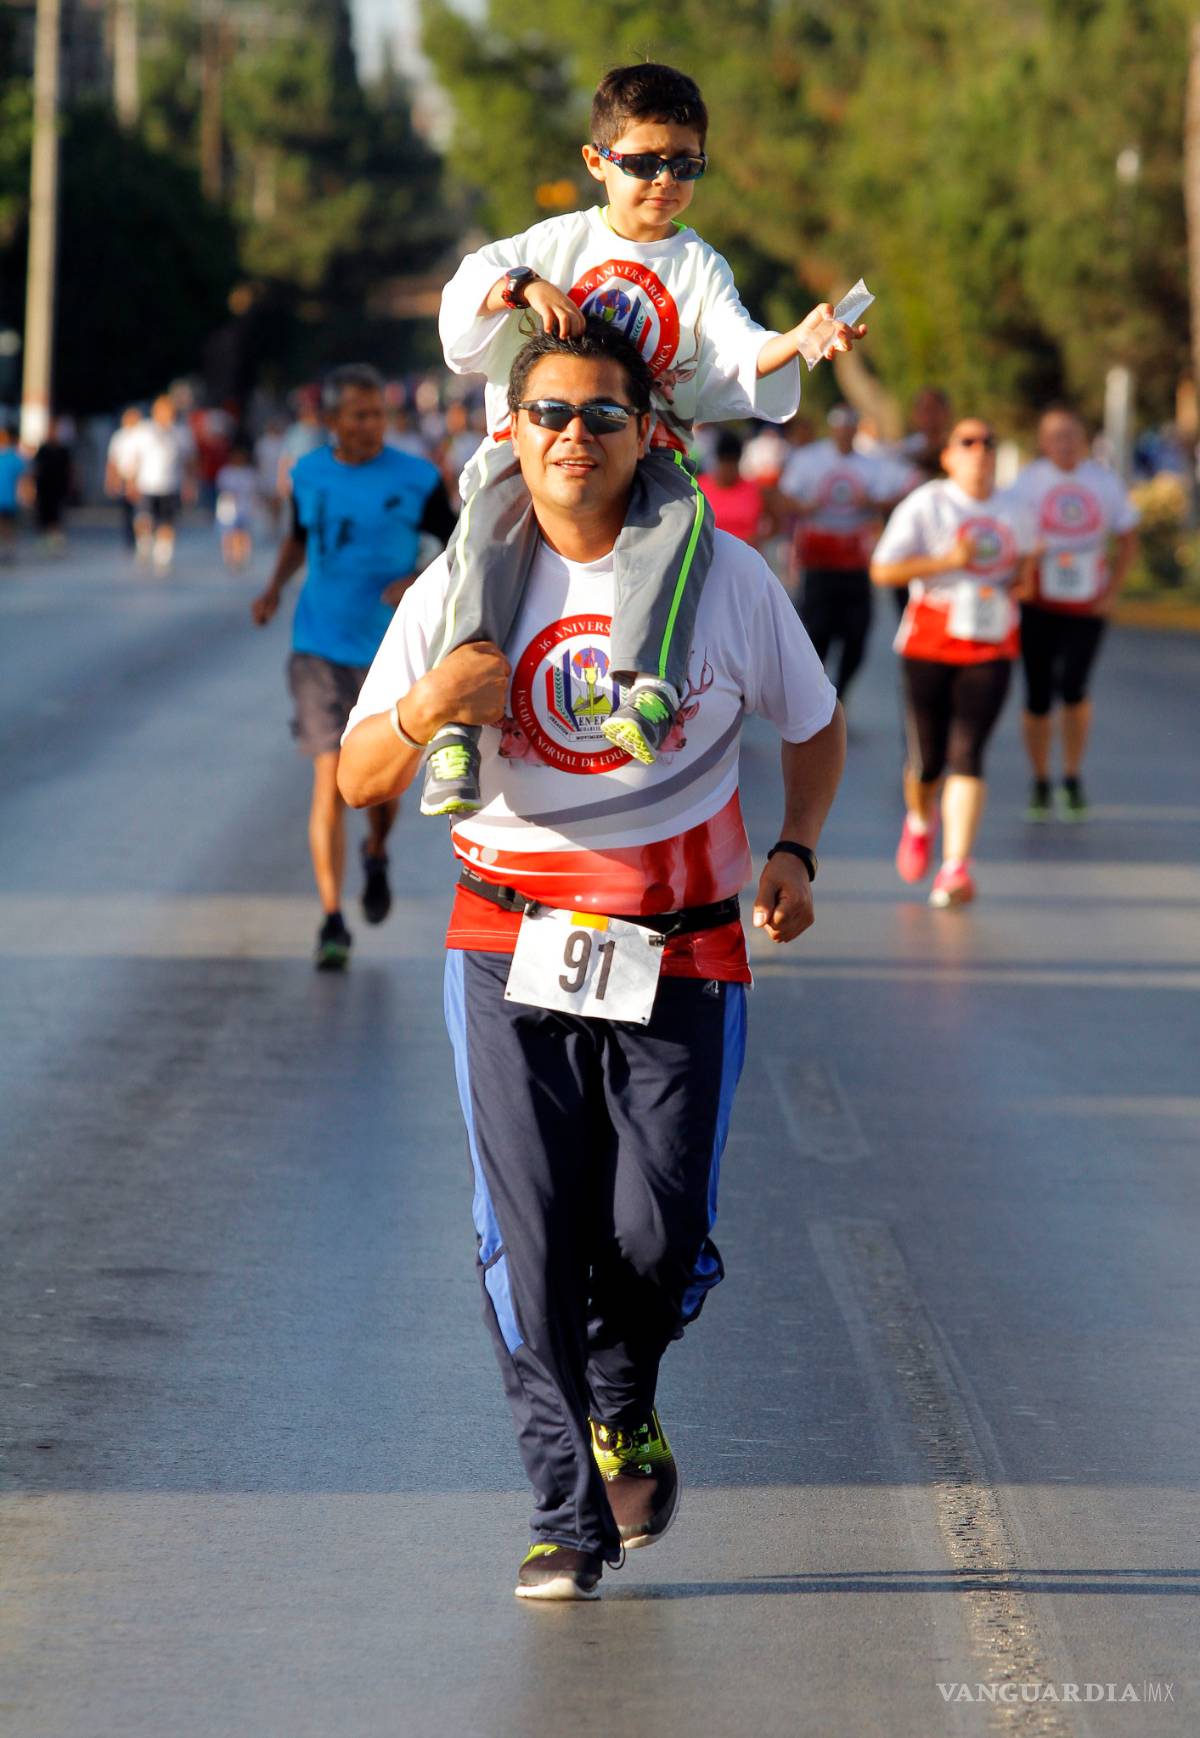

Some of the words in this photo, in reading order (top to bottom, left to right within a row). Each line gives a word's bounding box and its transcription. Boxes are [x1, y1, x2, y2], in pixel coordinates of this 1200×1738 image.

[581, 281, 594, 294] 36
[596, 265, 667, 307] ANIVERSARIO
[538, 639, 552, 652] 36
[555, 620, 611, 639] ANIVERS
[538, 735, 577, 766] NORMAL
[581, 757, 595, 768] DE
[559, 930, 616, 1001] 91
